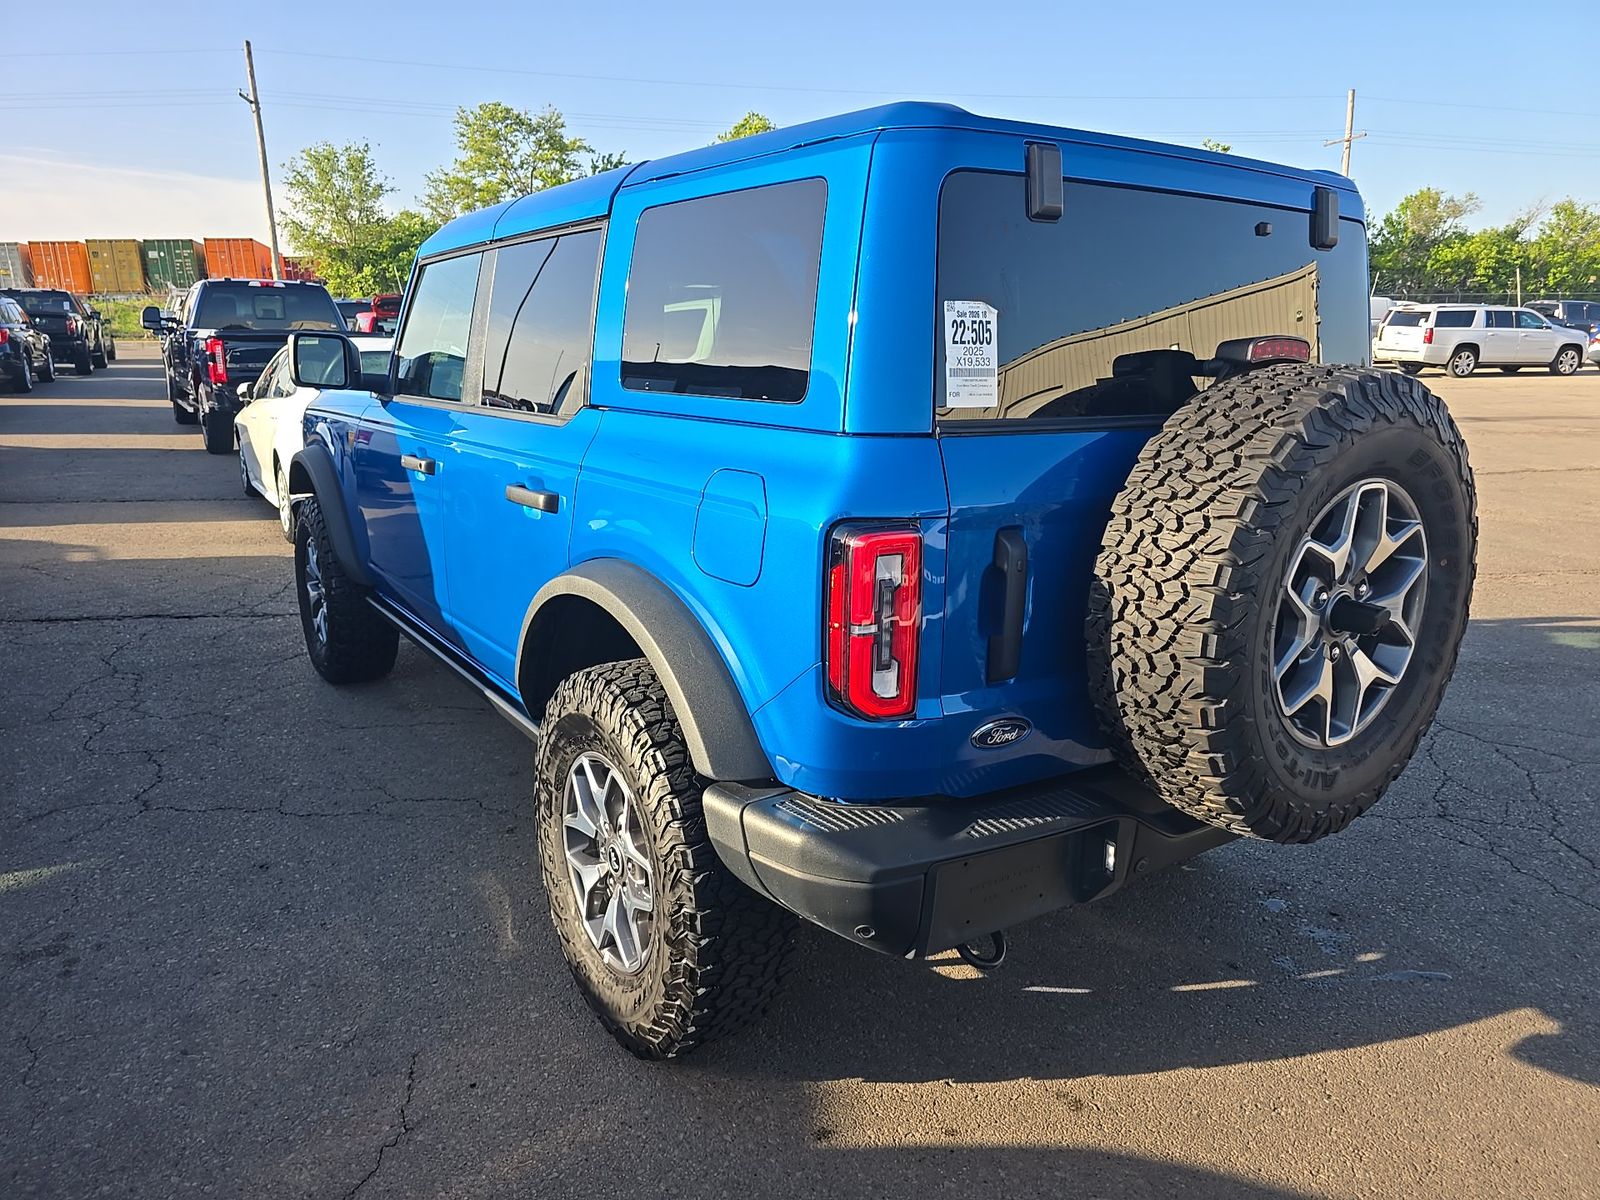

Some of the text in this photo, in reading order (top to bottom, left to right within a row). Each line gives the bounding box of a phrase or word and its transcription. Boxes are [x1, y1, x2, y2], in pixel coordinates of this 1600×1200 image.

[956, 310, 968, 319] Sale
[951, 319, 992, 346] 22:505
[963, 346, 984, 356] 2025
[956, 357, 991, 367] X19,533
[987, 725, 1019, 744] Ford
